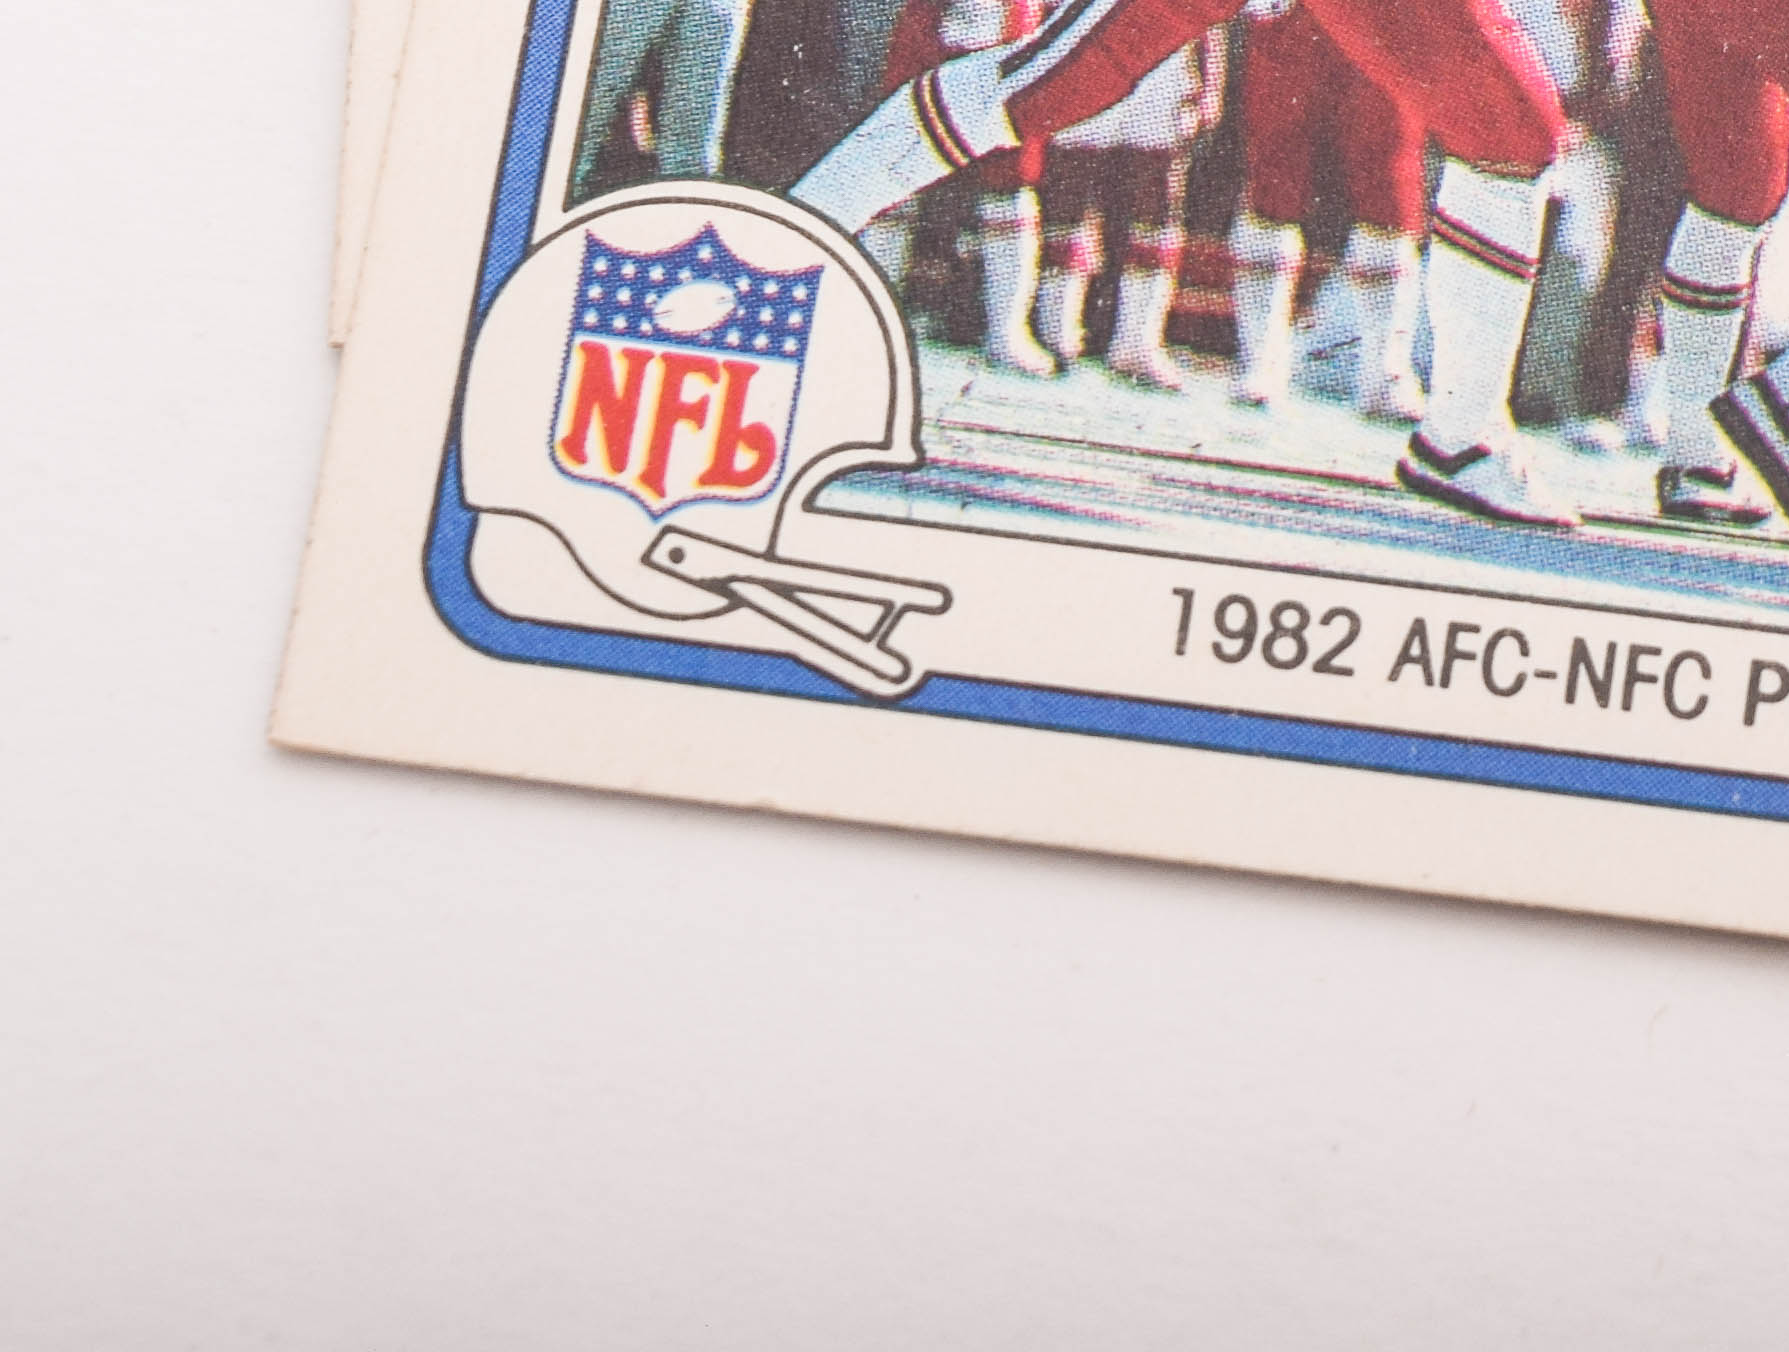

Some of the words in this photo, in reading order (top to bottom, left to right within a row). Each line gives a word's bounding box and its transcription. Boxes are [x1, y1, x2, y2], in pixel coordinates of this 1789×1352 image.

[556, 340, 778, 500] NFL
[1171, 586, 1363, 677] 1982
[1387, 617, 1713, 720] AFC-NFC
